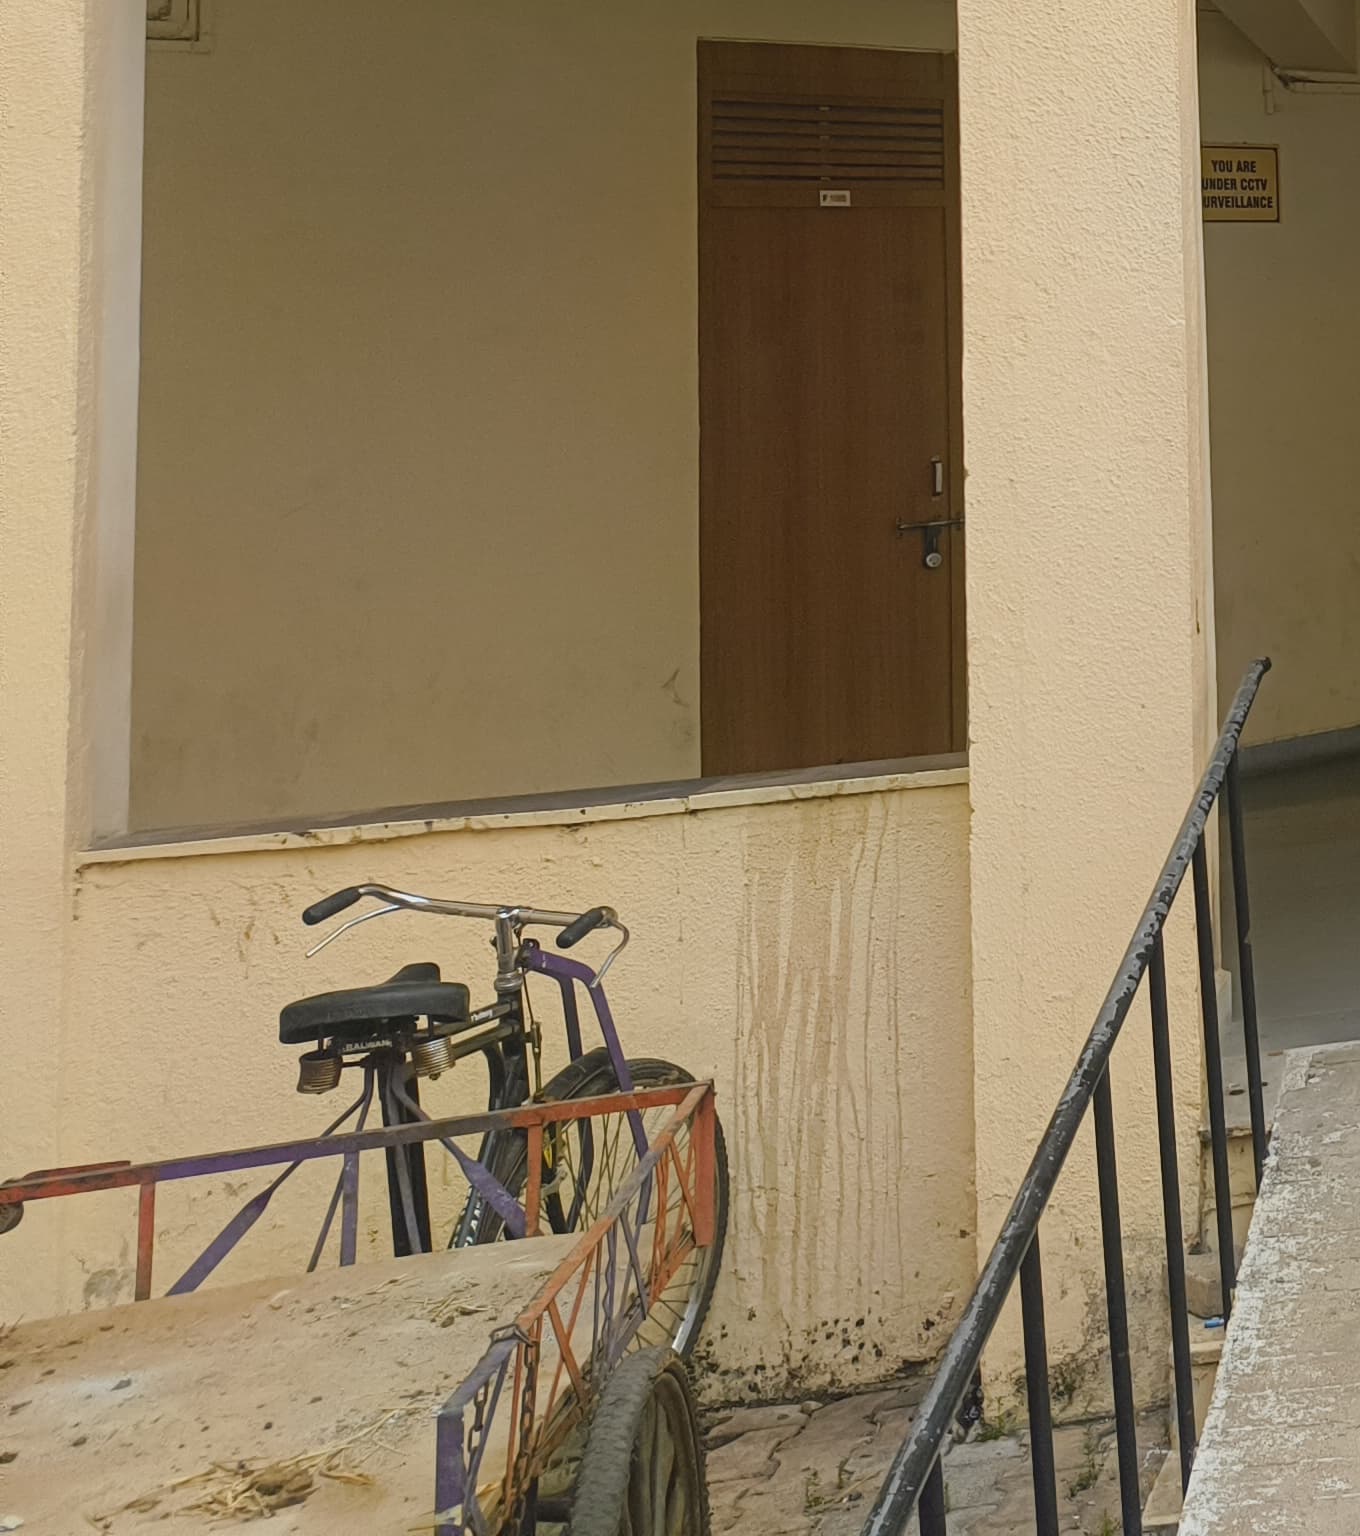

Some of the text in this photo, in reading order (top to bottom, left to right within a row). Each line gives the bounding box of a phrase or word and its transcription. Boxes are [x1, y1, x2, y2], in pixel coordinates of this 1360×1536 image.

[1211, 159, 1257, 173] YOU ARE
[1202, 178, 1268, 191] UNDER CCTV
[1202, 195, 1274, 209] URVEILLANCE
